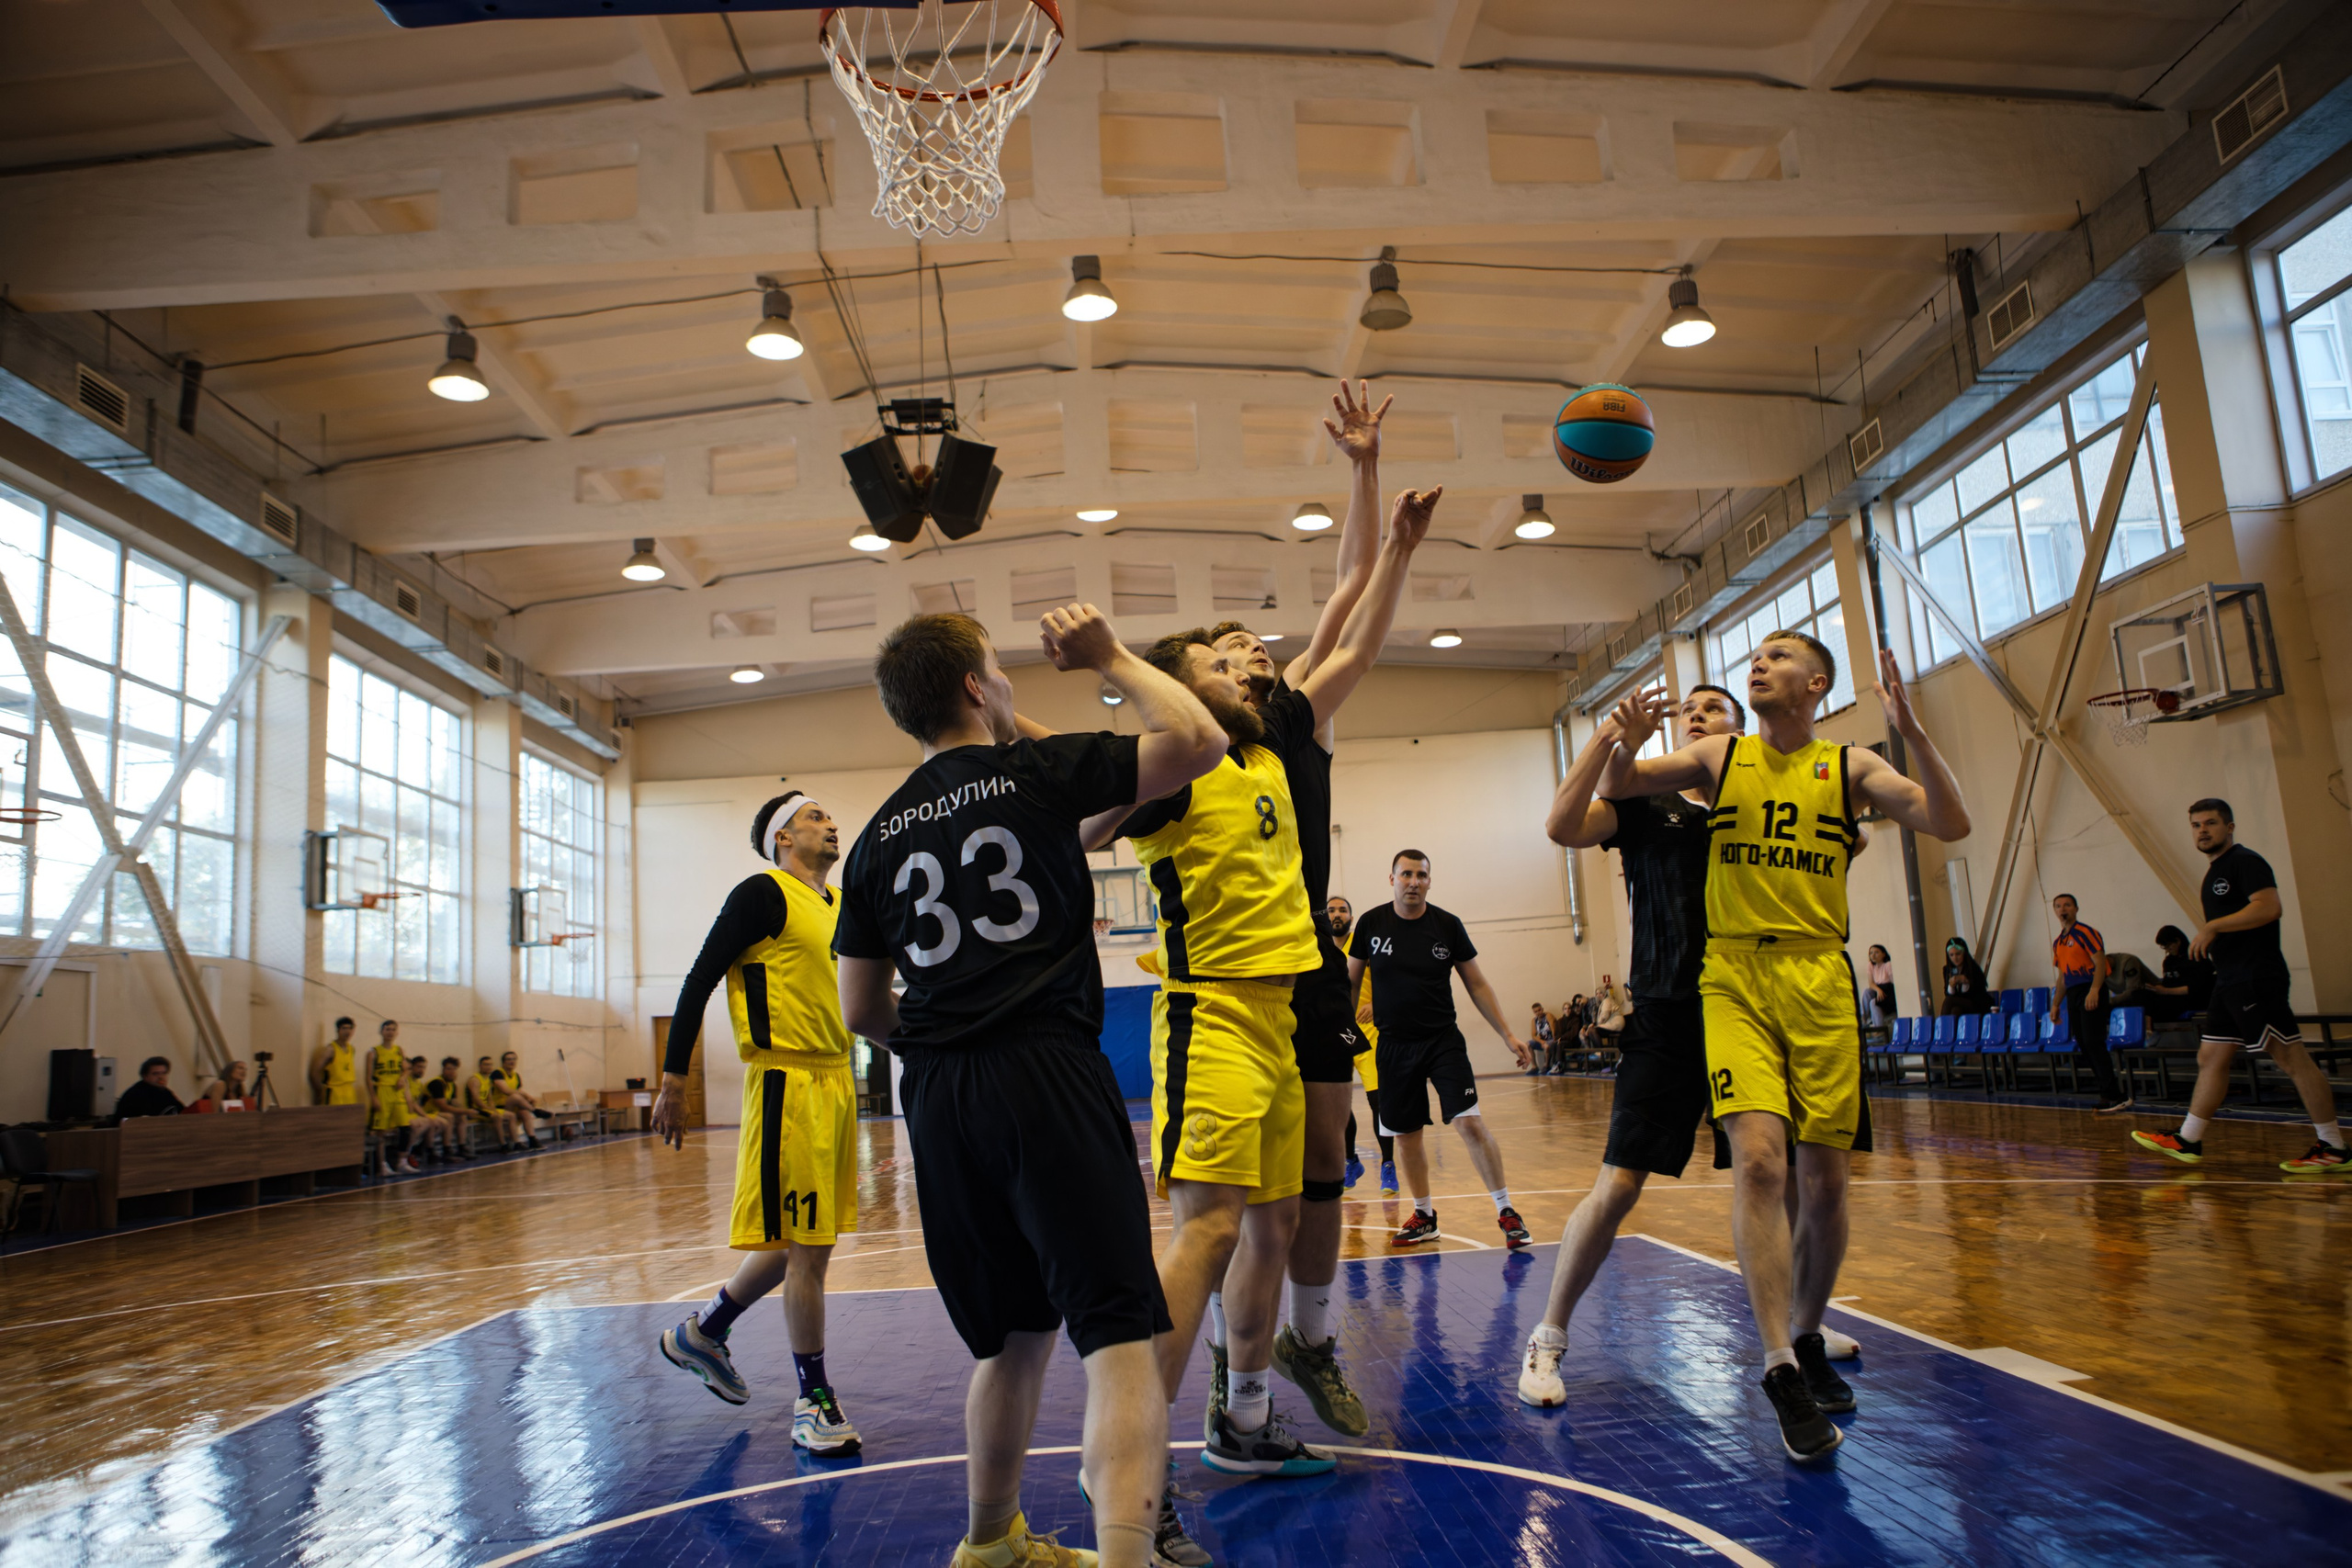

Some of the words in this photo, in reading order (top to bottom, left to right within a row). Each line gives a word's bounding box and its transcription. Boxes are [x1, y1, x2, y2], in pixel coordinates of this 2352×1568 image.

[879, 776, 1016, 842] БОРОДУЛИН
[1255, 795, 1278, 840] 8
[1761, 800, 1798, 841] 12
[1720, 842, 1836, 878] ЮГО-КАМСК
[893, 826, 1040, 967] 33
[1371, 936, 1393, 955] 94
[1711, 1068, 1735, 1101] 12
[1184, 1112, 1217, 1161] 8
[784, 1190, 818, 1230] 41
